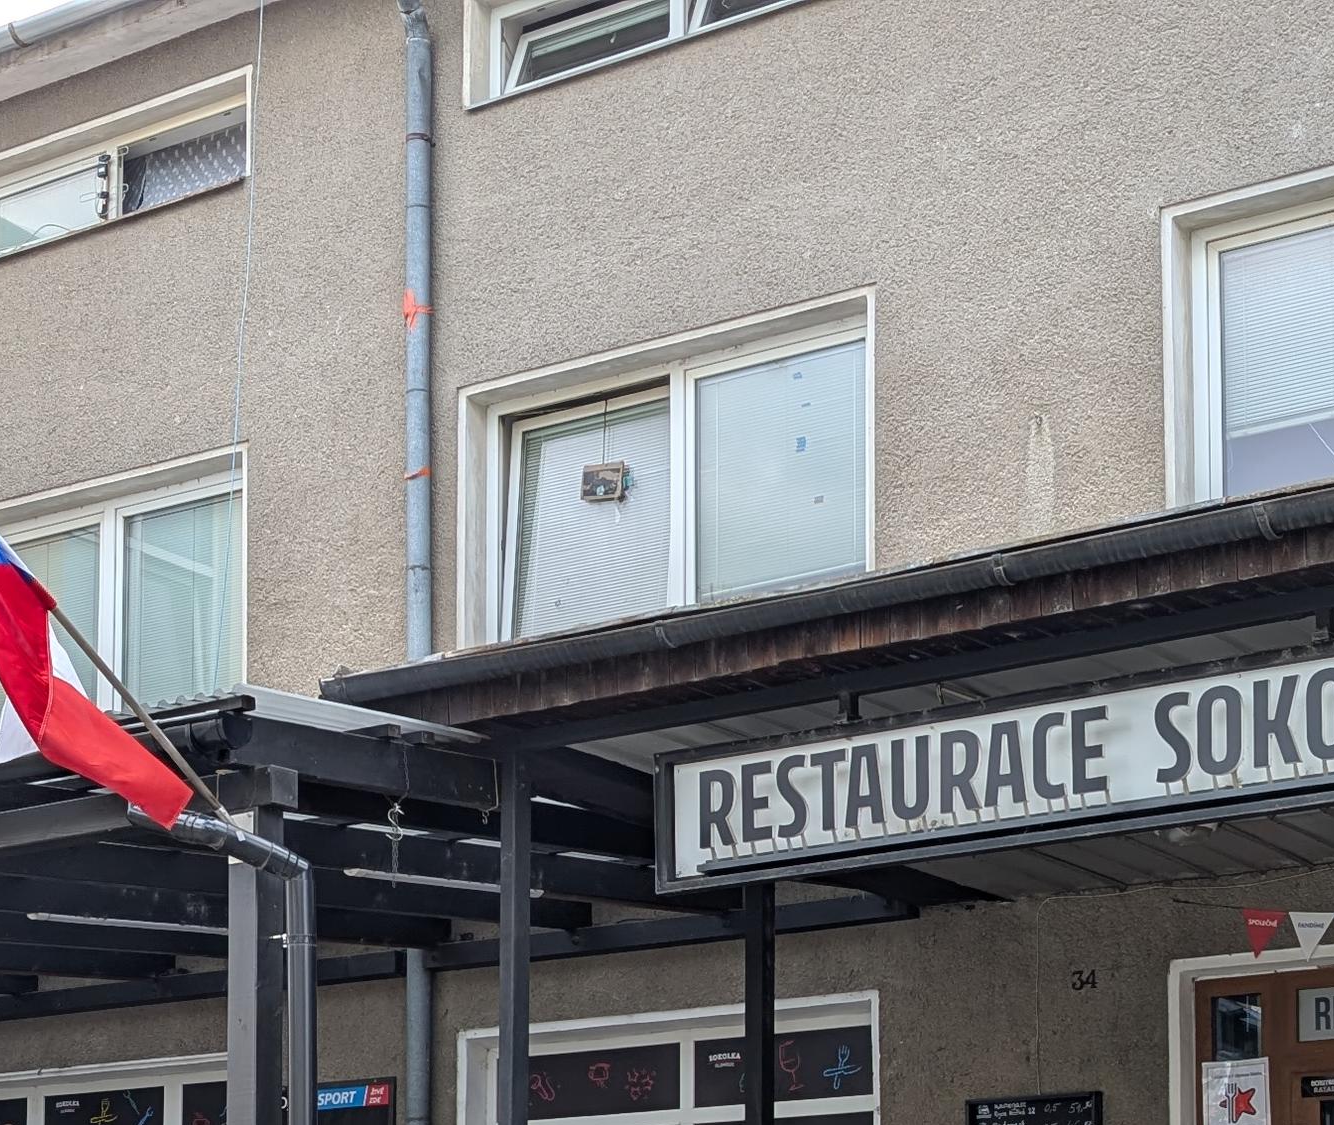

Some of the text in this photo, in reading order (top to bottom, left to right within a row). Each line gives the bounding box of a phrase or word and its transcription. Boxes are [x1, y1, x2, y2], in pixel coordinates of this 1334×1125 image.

[699, 705, 1110, 850] RESTAURACE
[1072, 969, 1099, 990] 34
[318, 1091, 357, 1106] SPORT
